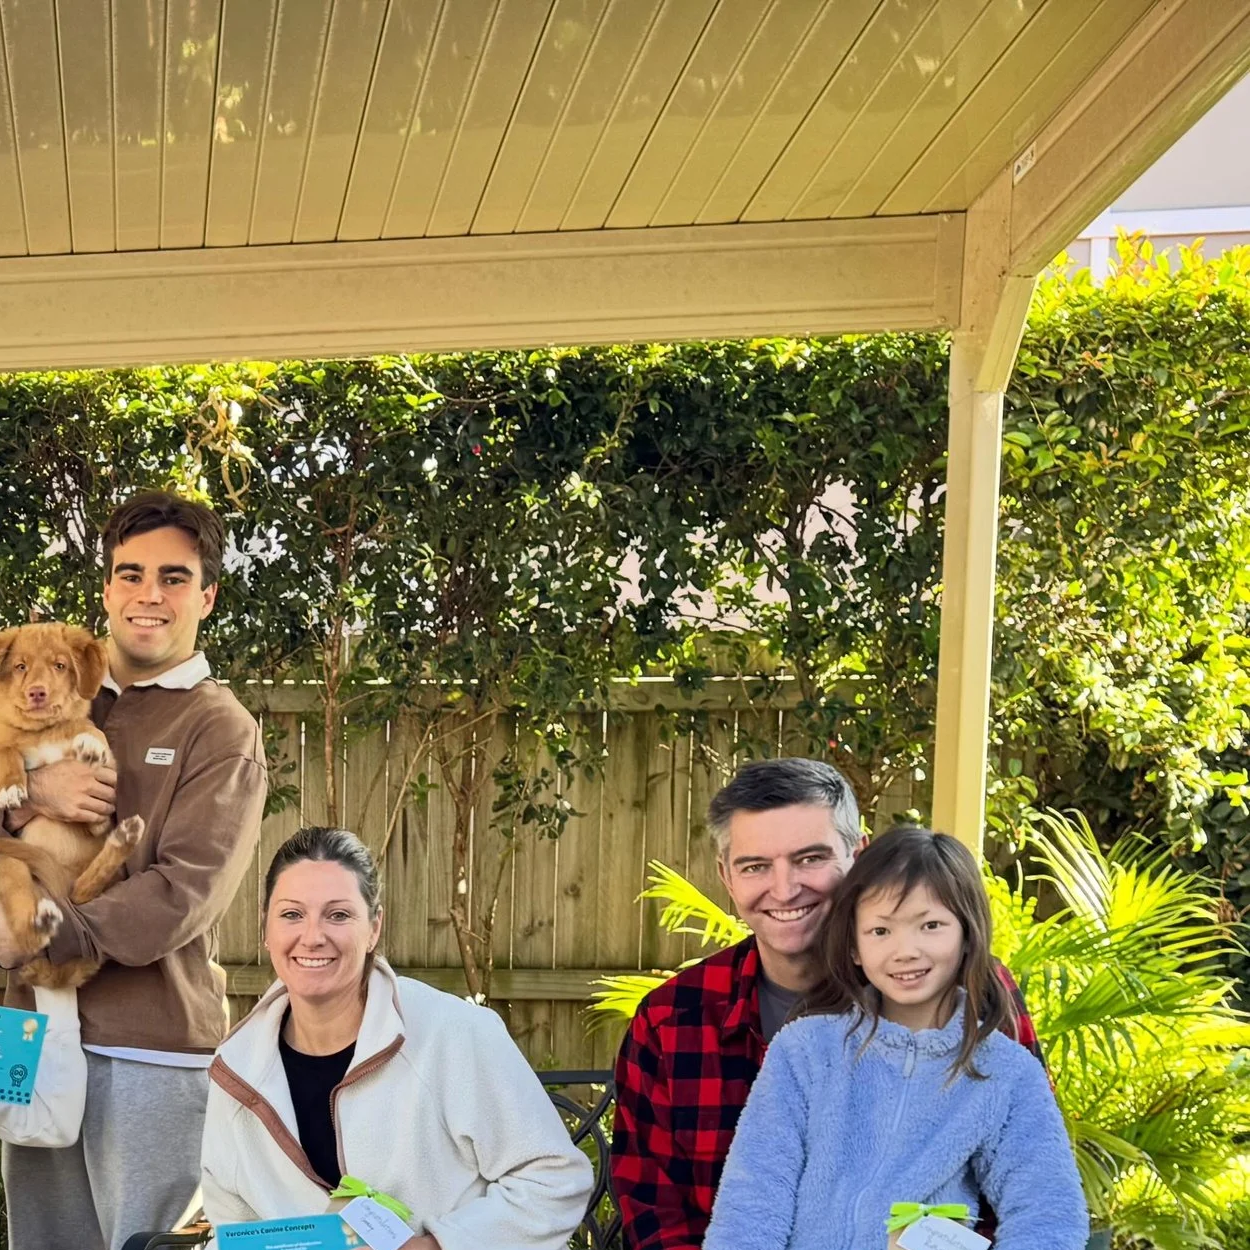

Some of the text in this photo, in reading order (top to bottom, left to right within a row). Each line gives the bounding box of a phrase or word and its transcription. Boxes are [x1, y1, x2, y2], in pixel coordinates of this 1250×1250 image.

[225, 1223, 315, 1238] Veronica's Canine Concepts
